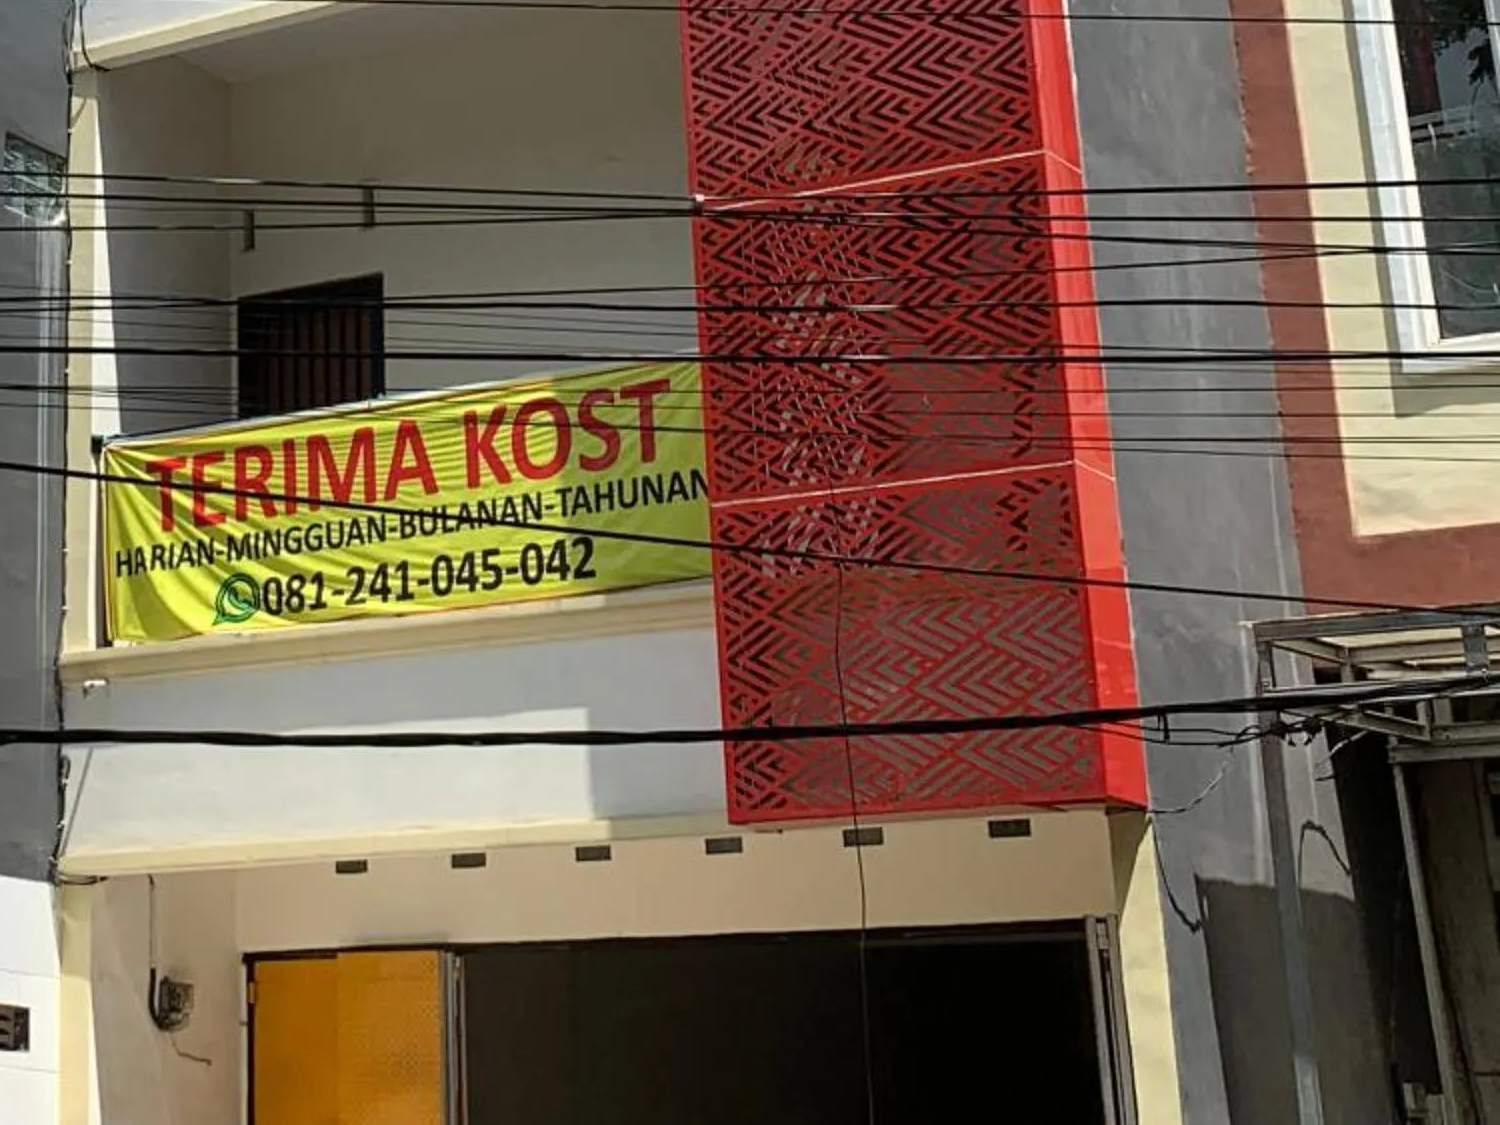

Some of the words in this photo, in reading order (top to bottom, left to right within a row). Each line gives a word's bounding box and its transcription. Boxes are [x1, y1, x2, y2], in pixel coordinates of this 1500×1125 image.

[146, 419, 438, 533] TERIMA
[463, 378, 670, 489] KOST
[262, 536, 597, 617] 081-241-045-042
